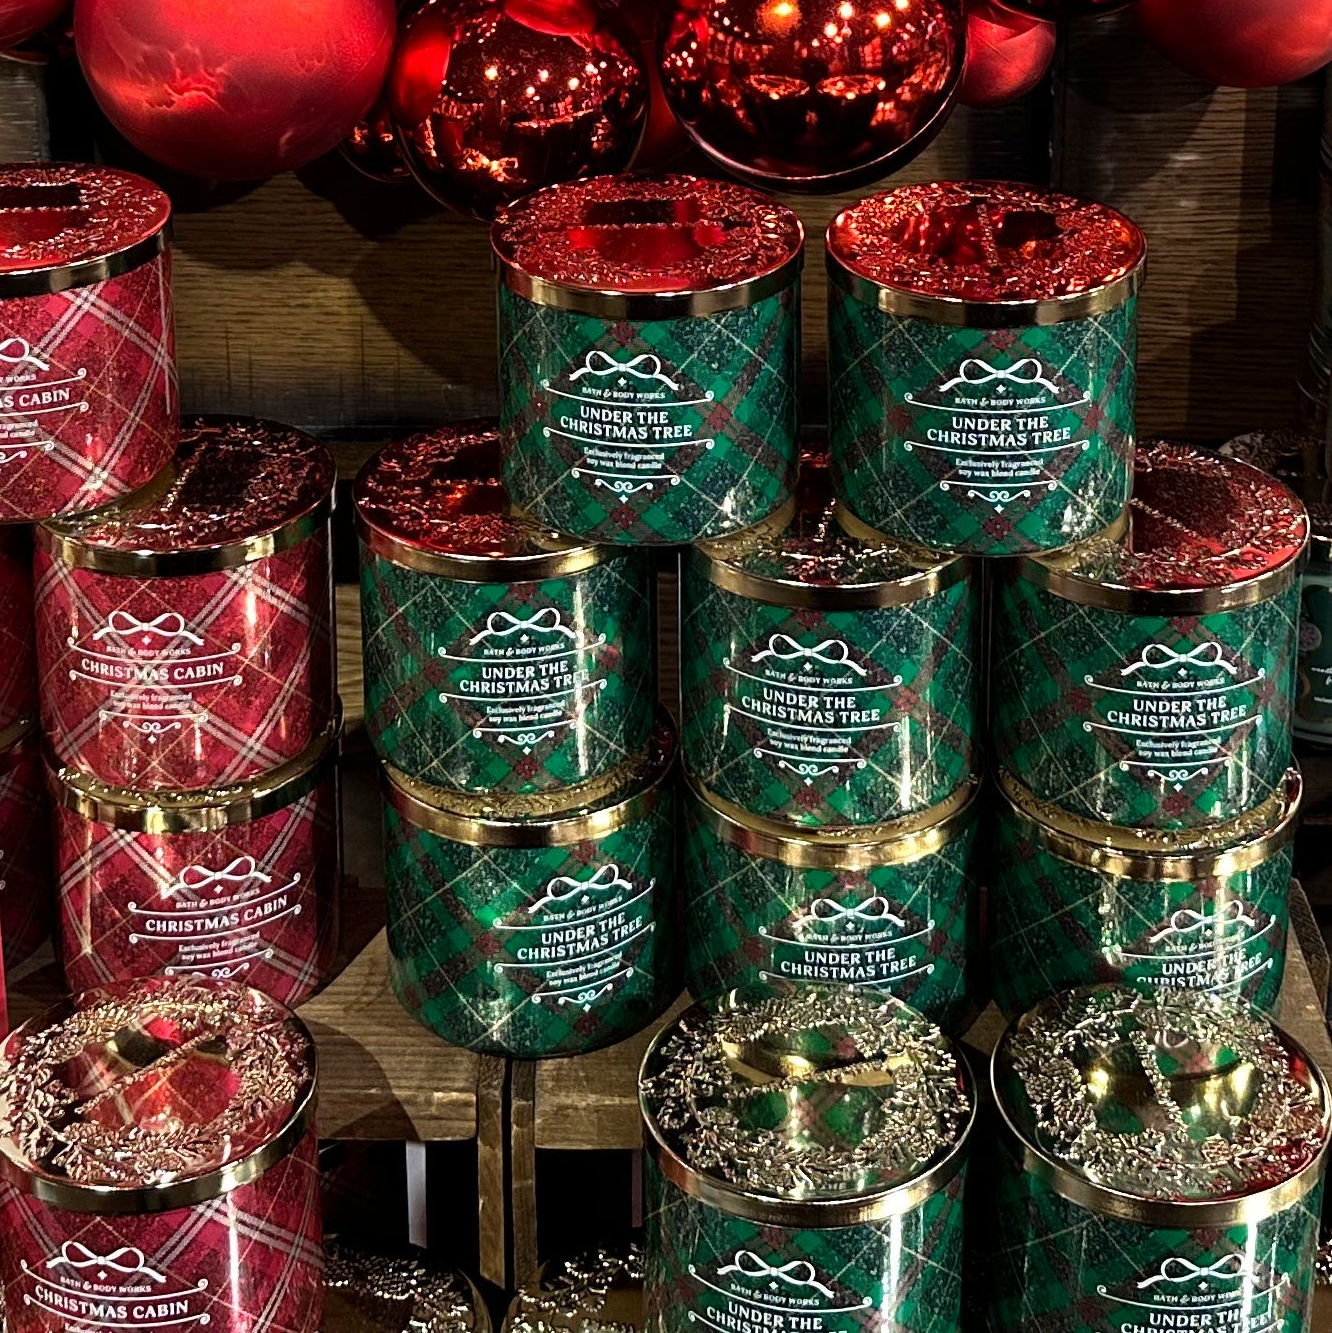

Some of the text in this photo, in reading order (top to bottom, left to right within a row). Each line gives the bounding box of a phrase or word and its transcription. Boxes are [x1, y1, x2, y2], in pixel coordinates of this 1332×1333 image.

[19, 388, 70, 407] CABIN
[580, 405, 669, 424] UNDER THE
[952, 416, 1049, 431] UNDER THE
[560, 416, 693, 440] CHRISTMAS TREE
[927, 427, 1071, 447] CHRISTMAS TREE
[81, 658, 224, 680] CHRISTMAS CABIN
[482, 660, 569, 679] UNDER THE
[459, 668, 589, 694] CHRISTMAS TREE
[763, 687, 856, 709] UNDER THE
[1133, 695, 1227, 713] UNDER THE
[741, 695, 880, 724] CHRISTMAS TREE
[1107, 705, 1247, 729] CHRISTMAS TREE
[145, 894, 288, 933] CHRISTMAS CABIN
[517, 915, 643, 960] CHRISTMAS TREE
[541, 911, 626, 945] UNDER THE
[780, 955, 917, 980] CHRISTMAS TREE
[804, 948, 896, 965] UNDER THE
[1162, 960, 1216, 976] UNDER
[35, 1285, 189, 1319] CHRISTMAS CABIN
[728, 1301, 784, 1327] UNDER
[789, 1318, 823, 1330] THE
[1149, 1312, 1212, 1327] UNDER
